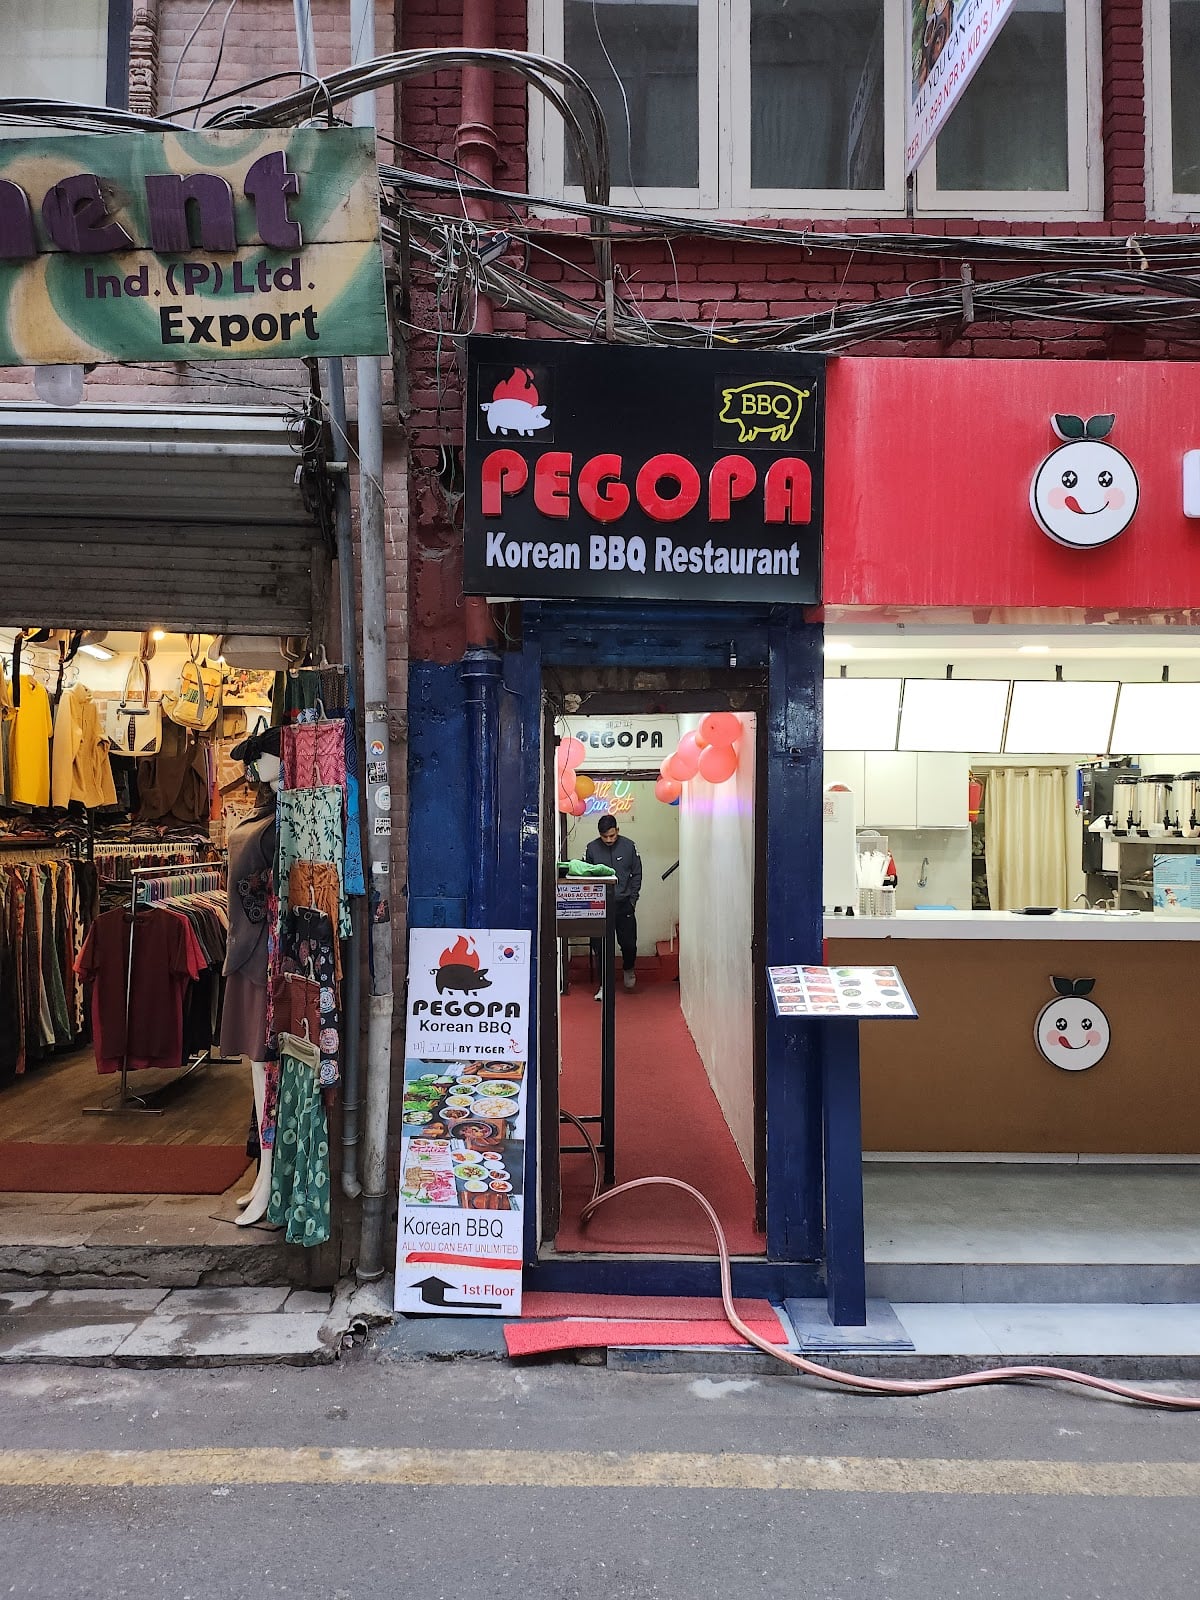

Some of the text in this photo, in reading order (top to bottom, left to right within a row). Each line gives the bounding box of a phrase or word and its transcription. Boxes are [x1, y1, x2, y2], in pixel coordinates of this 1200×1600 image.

[914, 0, 983, 124] ALL YOU CAN EA
[943, 63, 959, 104] NPR
[160, 304, 320, 347] Export
[741, 393, 793, 420] BBQ
[481, 448, 813, 526] PEGOPA
[486, 531, 801, 577] Korean BBQ Restaurant
[575, 730, 664, 749] PEGOPA
[607, 793, 635, 815] Eat
[412, 999, 521, 1018] PEGOPA
[419, 1019, 512, 1036] Korean BBQ
[459, 1044, 505, 1054] BY TIGER
[403, 1216, 504, 1239] Korean BBQ
[402, 1241, 519, 1255] ALL YOU CAN EAT UNLIMITED
[462, 1283, 515, 1297] 1st Floor
